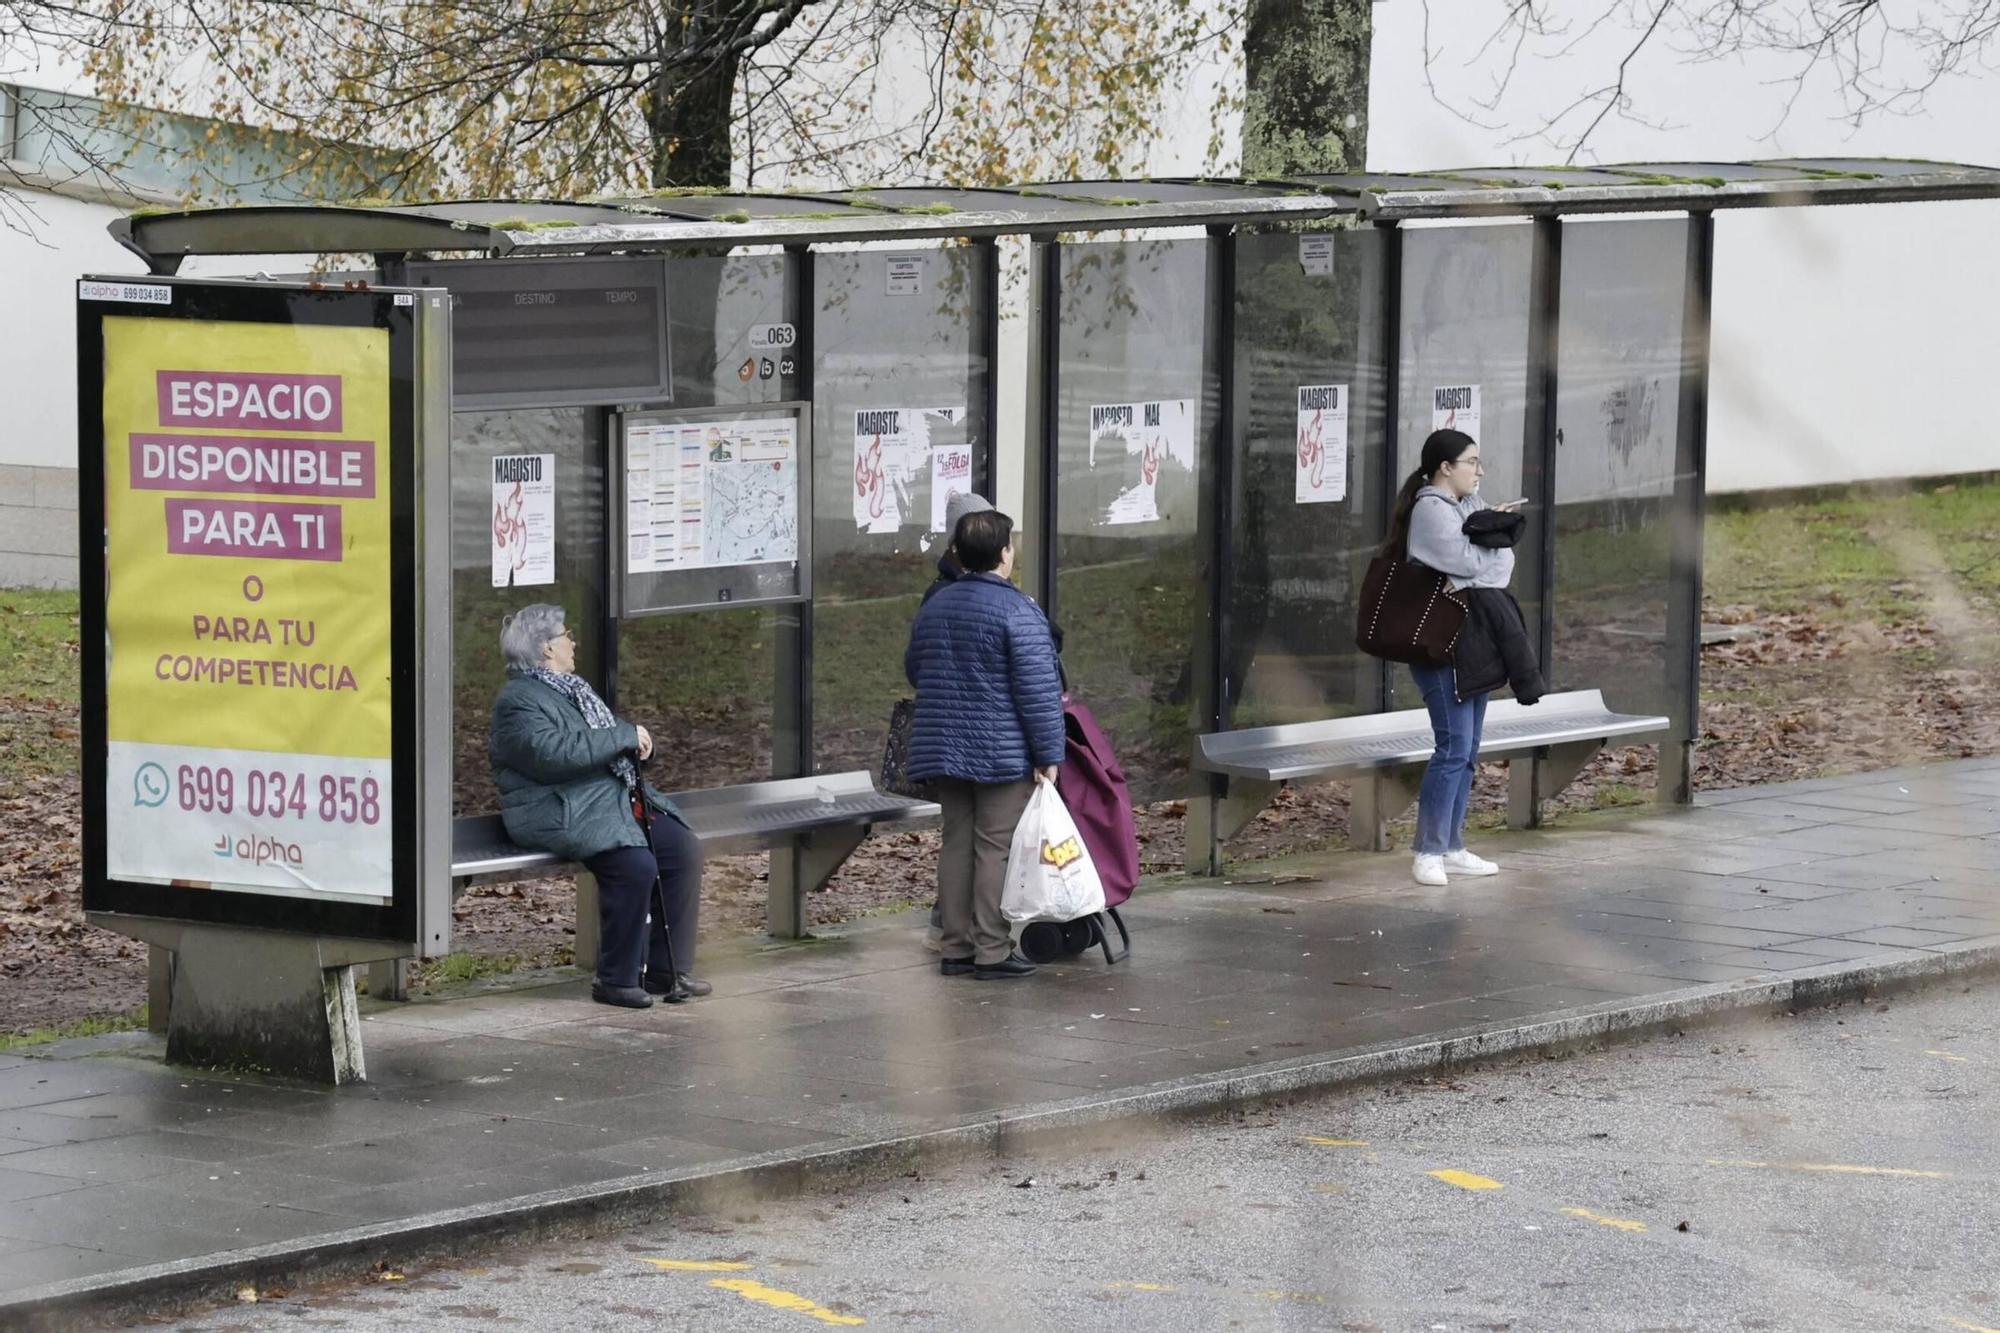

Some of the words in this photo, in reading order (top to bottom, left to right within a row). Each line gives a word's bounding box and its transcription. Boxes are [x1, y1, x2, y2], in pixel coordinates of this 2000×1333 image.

[91, 285, 119, 298] alpha
[123, 287, 137, 299] 699
[138, 288, 152, 300] 034
[153, 289, 168, 301] 858
[514, 292, 556, 305] DESTINO
[604, 290, 637, 303] TEMPO
[768, 327, 793, 344] 063
[780, 360, 794, 375] C2
[170, 381, 333, 422] ESPACIO
[1300, 387, 1338, 410] MAGOSTO
[1435, 387, 1472, 410] MAGOSTO
[142, 444, 363, 487] DISPONIBLE
[495, 457, 542, 483] MAGOSTO
[182, 509, 286, 547] PARA
[293, 514, 325, 550] TI
[243, 575, 264, 602] O
[193, 615, 271, 645] PARA
[278, 620, 316, 647] TU
[155, 654, 358, 691] COMPETENCIA
[178, 765, 234, 814] 699
[247, 770, 307, 820] 034
[318, 775, 380, 825] 858
[236, 834, 303, 866] alpha
